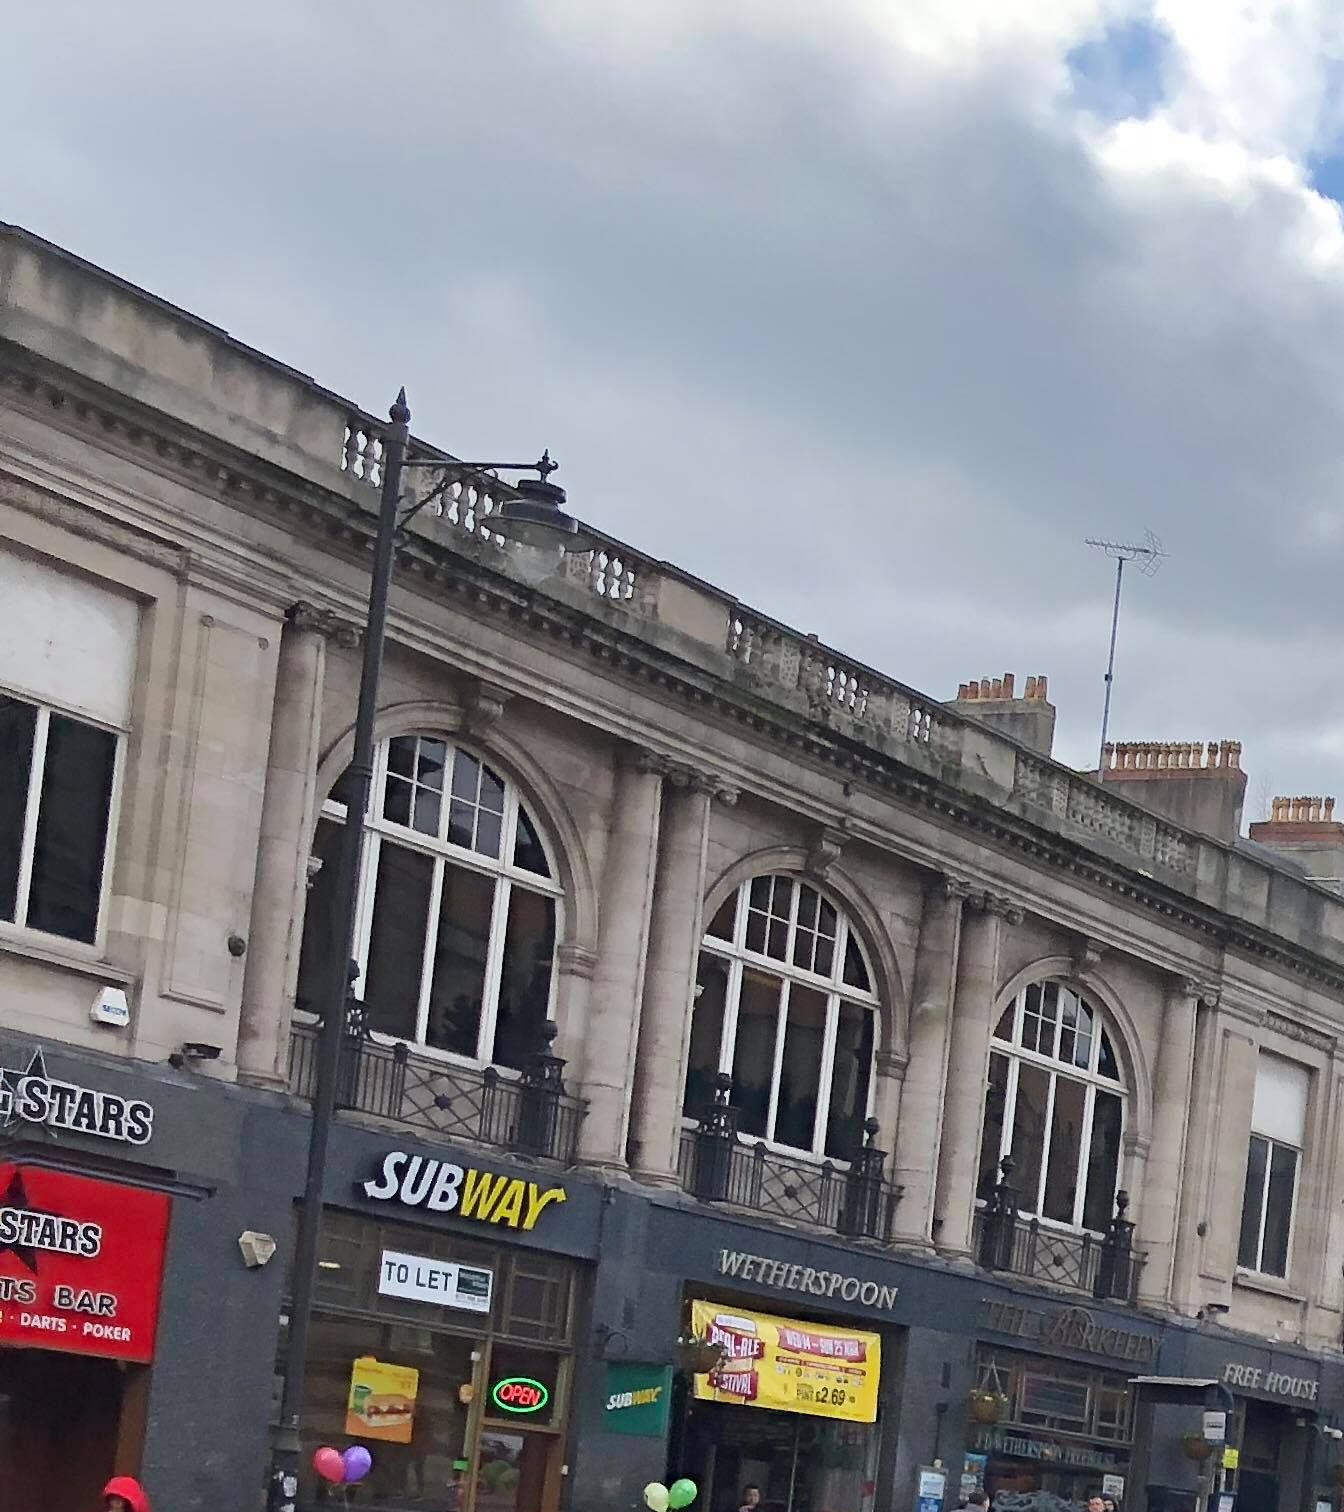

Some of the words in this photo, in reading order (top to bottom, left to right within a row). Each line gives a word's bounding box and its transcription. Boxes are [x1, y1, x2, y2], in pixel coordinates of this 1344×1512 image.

[17, 1077, 153, 1144] STARS
[364, 1151, 567, 1231] SUBWAY
[0, 1207, 102, 1258] STARS
[385, 1261, 409, 1284] TO
[415, 1267, 452, 1292] LET
[718, 1249, 898, 1310] WETHERSPOON
[55, 1284, 117, 1317] BAR
[20, 1312, 67, 1332] DARTS
[83, 1321, 131, 1342] POKER
[499, 1383, 541, 1407] OPEN
[606, 1386, 662, 1411] SUBWAY
[1223, 1363, 1263, 1388] FREE
[1264, 1372, 1320, 1400] HOUSE
